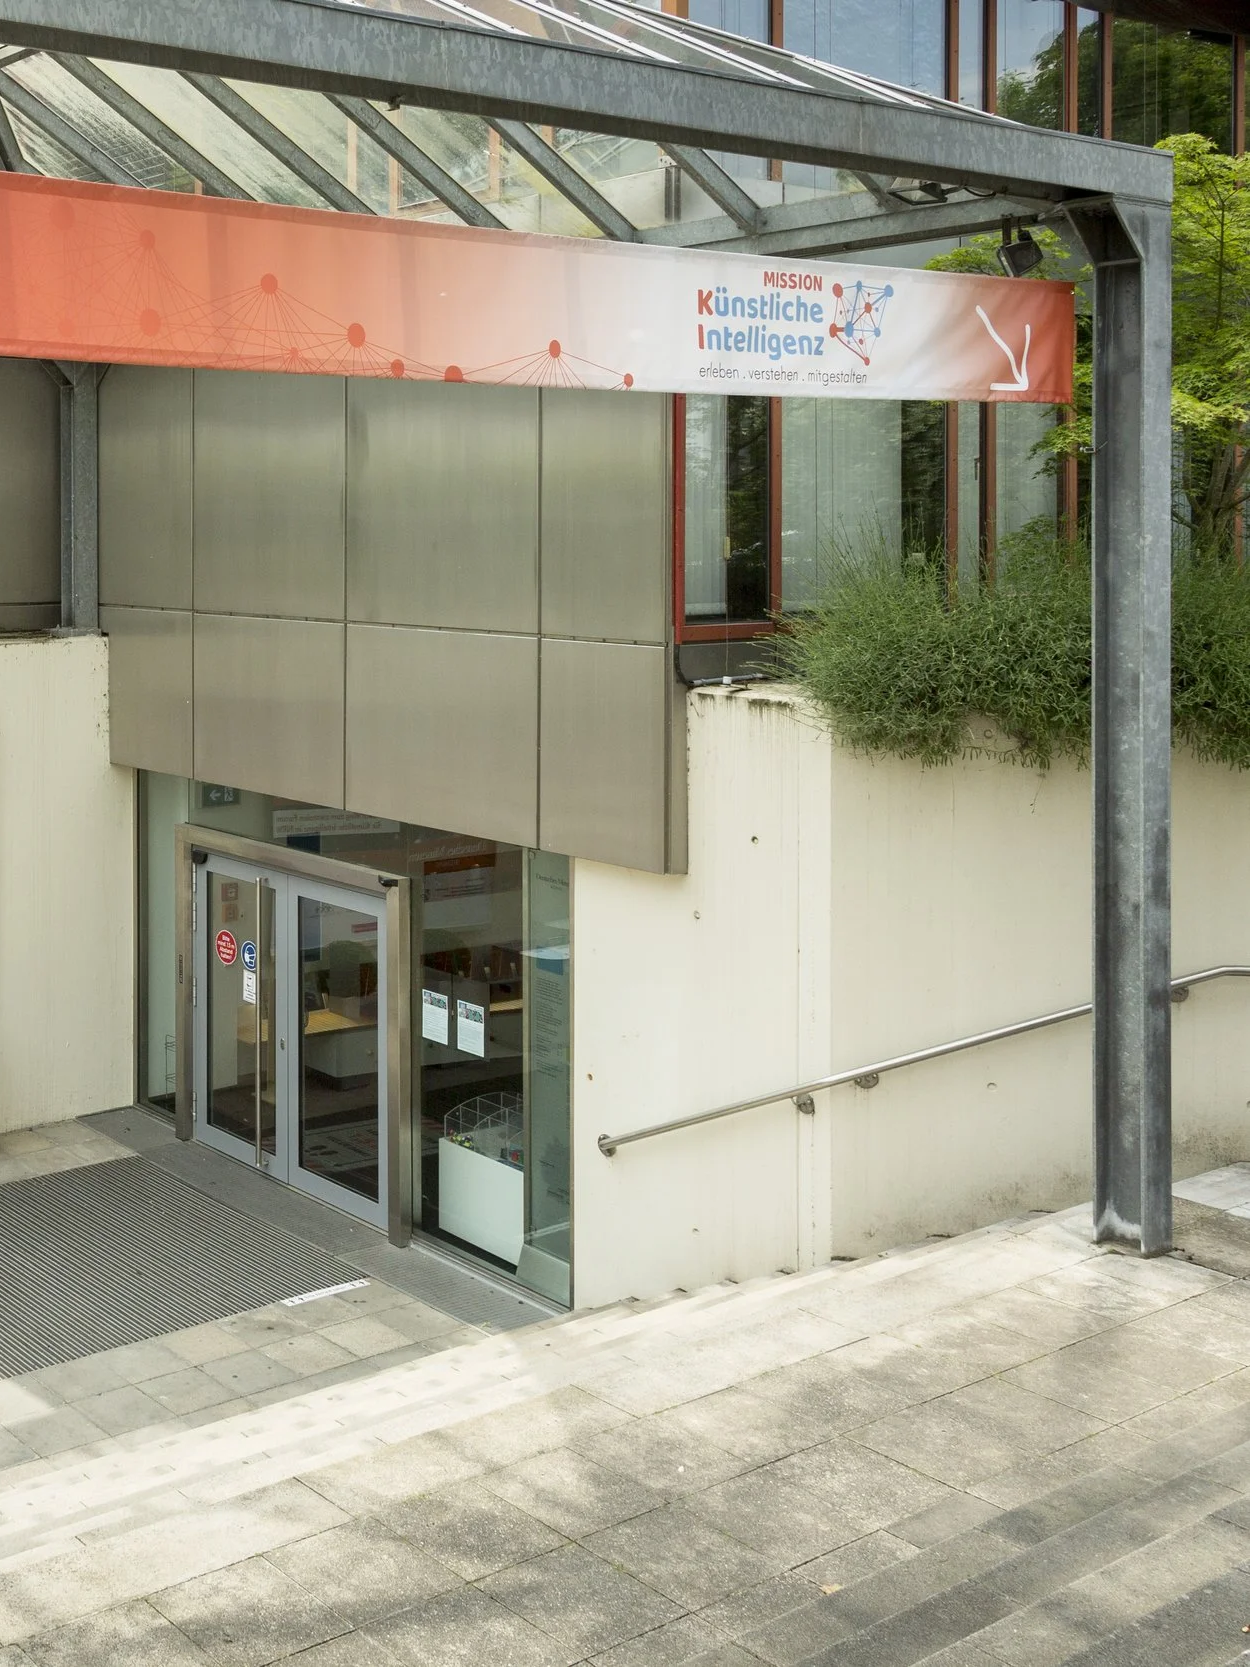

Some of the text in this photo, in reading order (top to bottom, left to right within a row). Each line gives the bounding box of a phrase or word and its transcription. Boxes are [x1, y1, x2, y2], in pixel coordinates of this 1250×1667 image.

[763, 271, 822, 292] MISSION
[697, 286, 823, 323] Künstliche
[698, 324, 824, 361] Intelligenz
[699, 362, 867, 386] erleben verstehen mitgestalten
